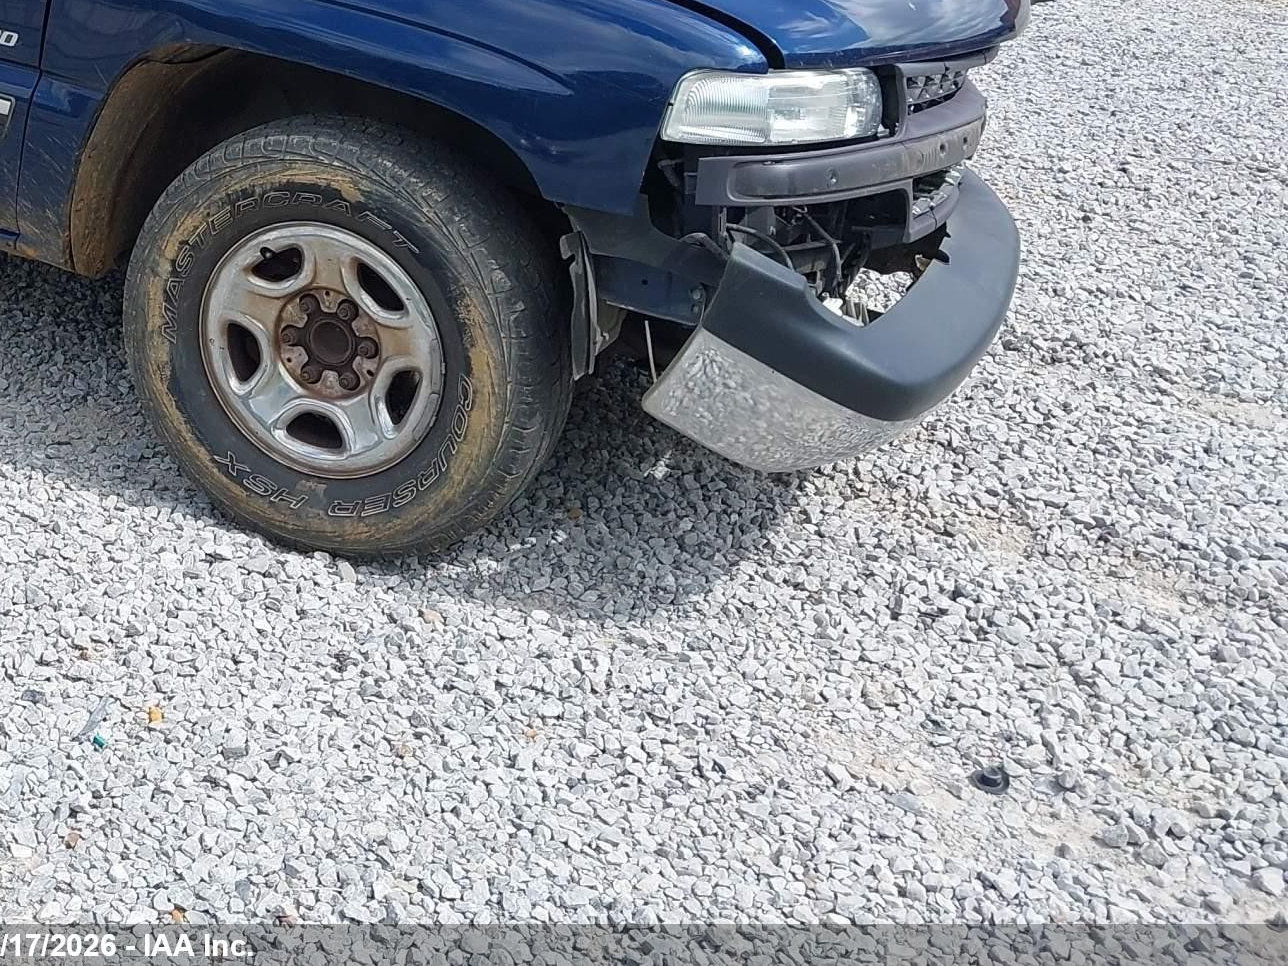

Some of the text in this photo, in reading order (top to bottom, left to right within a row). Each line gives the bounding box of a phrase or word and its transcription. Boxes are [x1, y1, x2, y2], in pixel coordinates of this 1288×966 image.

[160, 190, 419, 344] MASTERCRAFT
[213, 372, 474, 518] COURSER HSX
